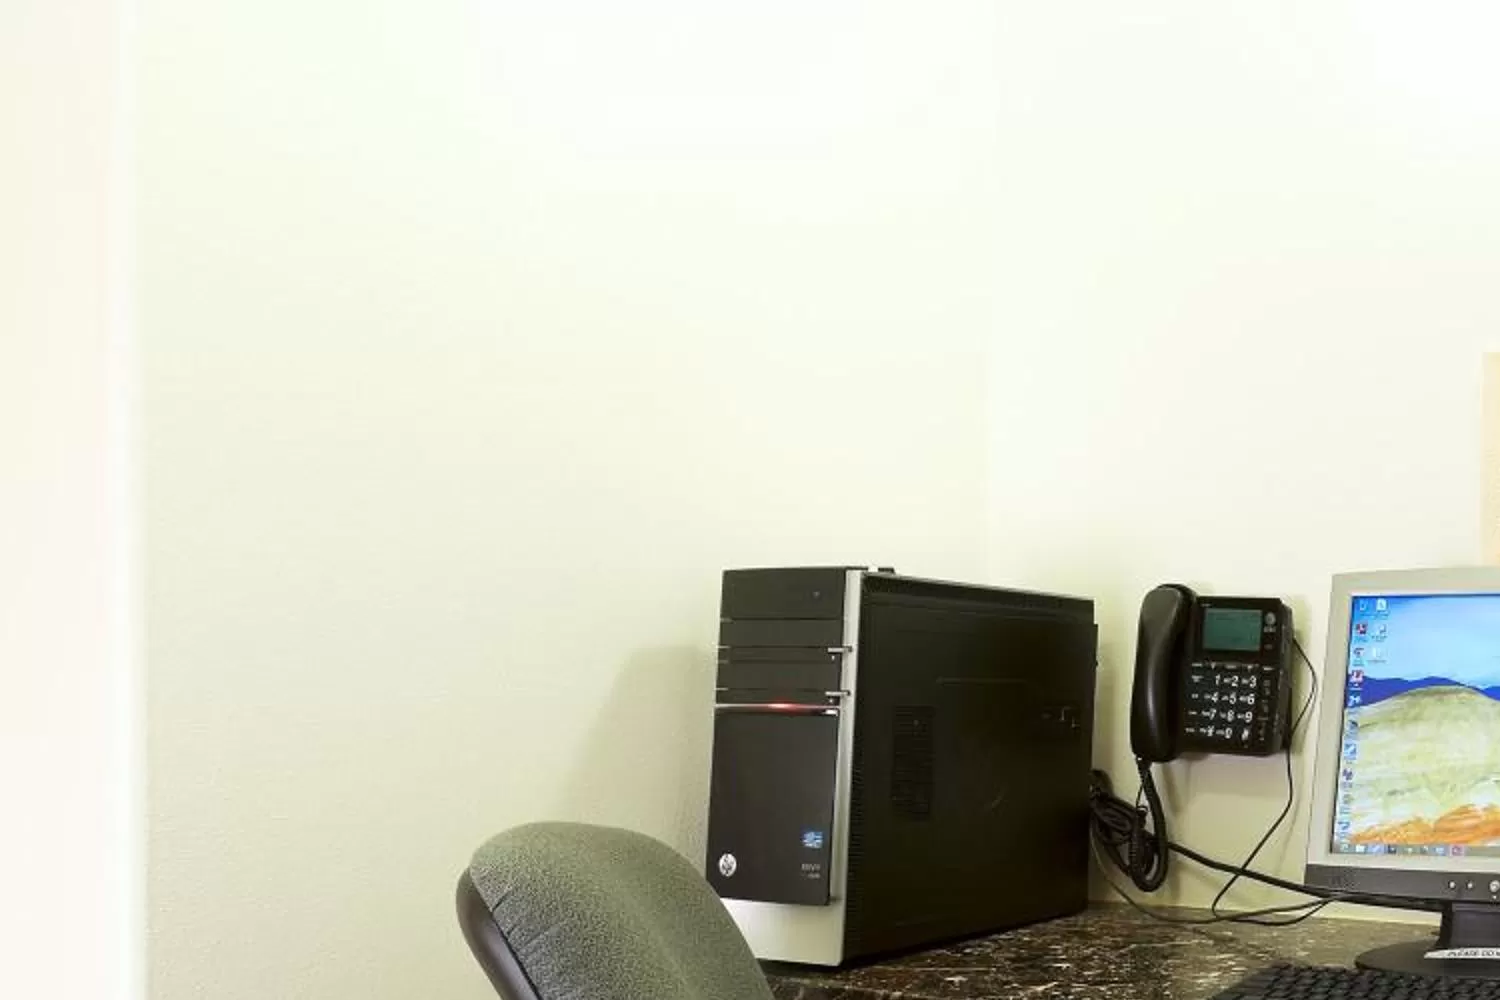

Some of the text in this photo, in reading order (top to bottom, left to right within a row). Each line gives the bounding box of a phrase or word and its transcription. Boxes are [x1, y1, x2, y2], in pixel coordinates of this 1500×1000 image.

[1215, 674, 1220, 686] 1
[1231, 675, 1239, 687] 2
[1249, 675, 1257, 689] 3
[1211, 691, 1219, 703] 4
[1229, 692, 1237, 705] 5
[1247, 693, 1255, 705] 6
[1210, 708, 1217, 721] 7
[1227, 709, 1235, 722] 8
[1245, 711, 1253, 723] 9
